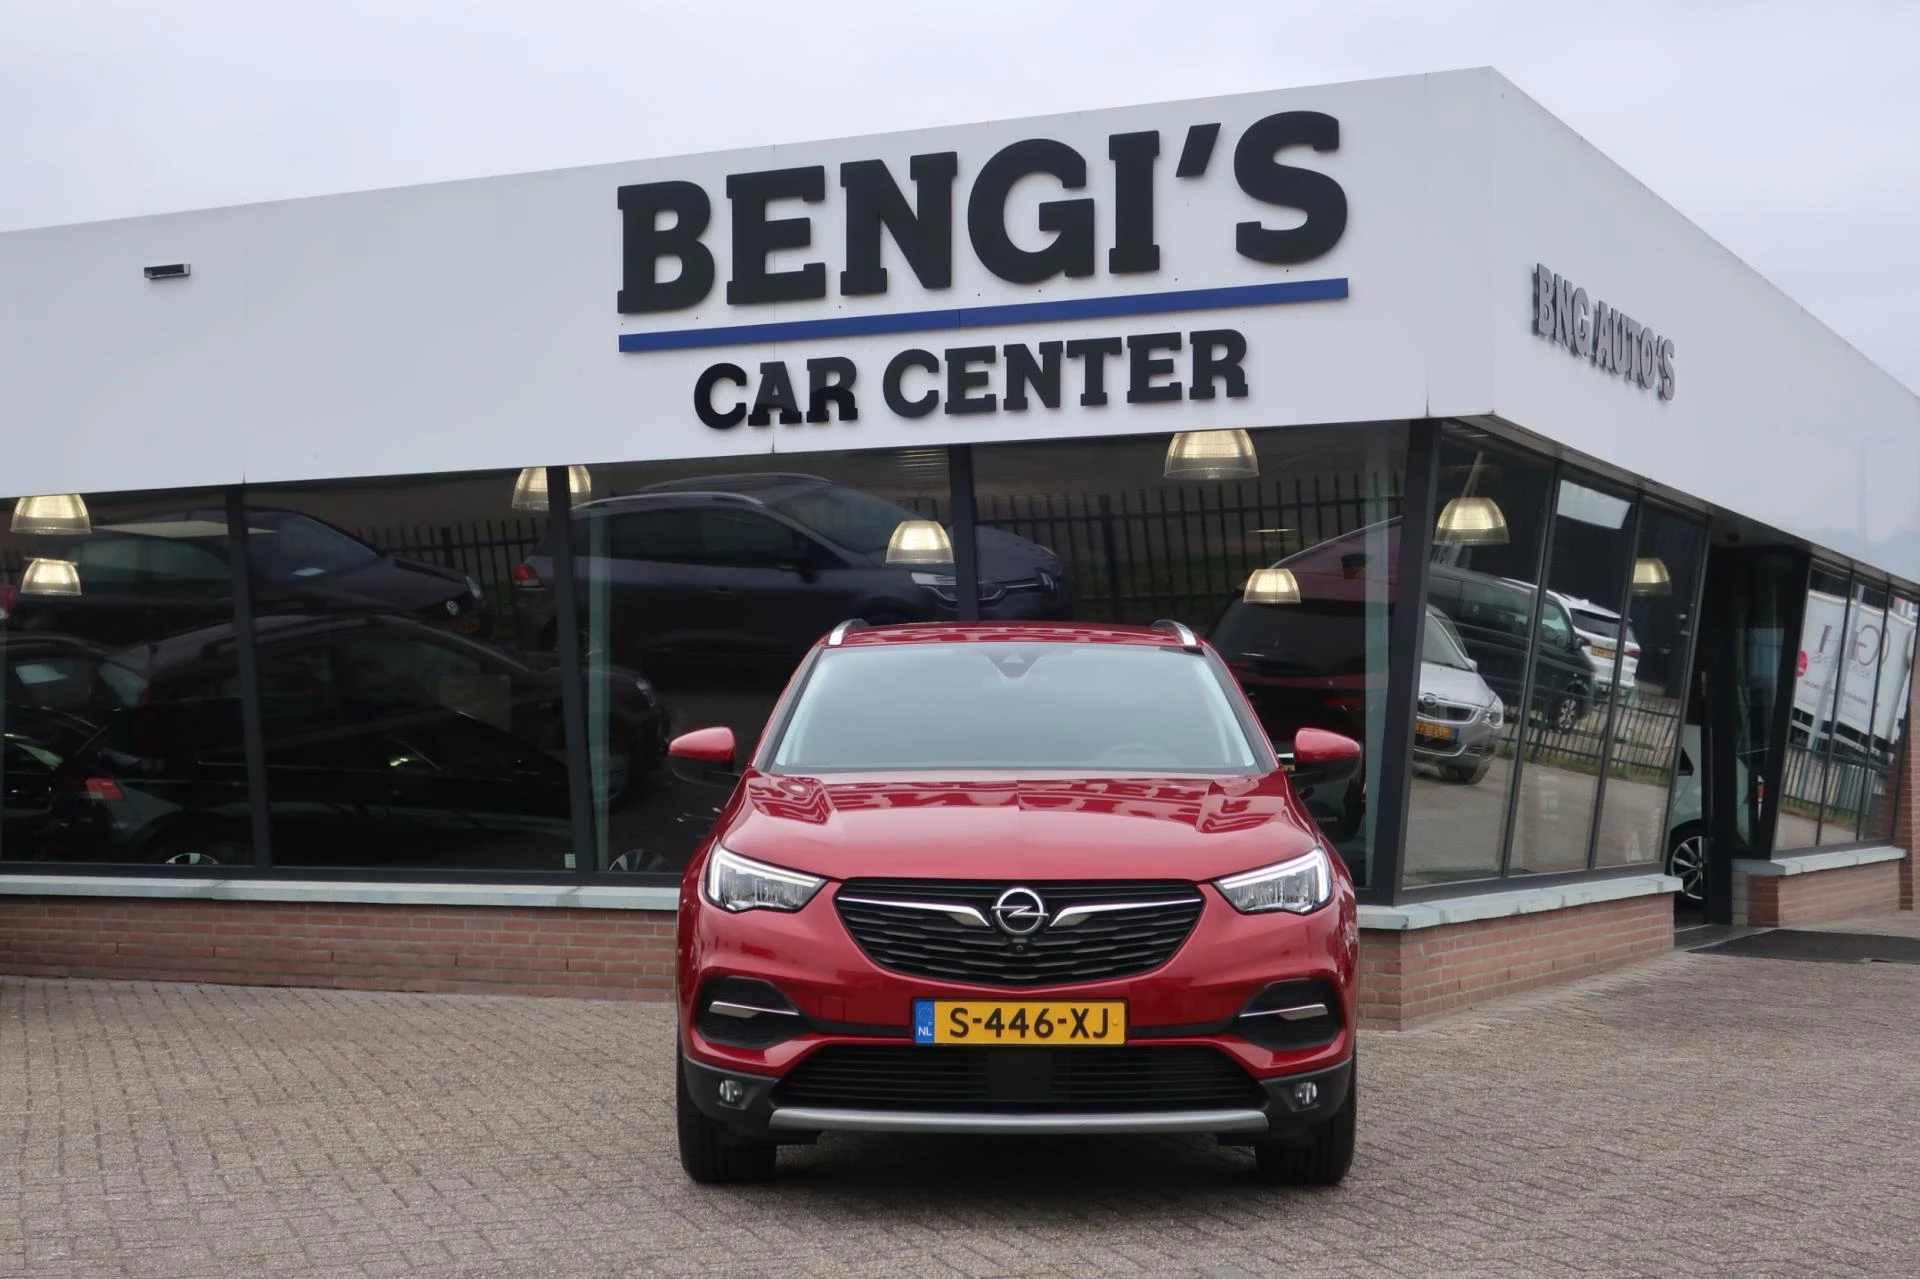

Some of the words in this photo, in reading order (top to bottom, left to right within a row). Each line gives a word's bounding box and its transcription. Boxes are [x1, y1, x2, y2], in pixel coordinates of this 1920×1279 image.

[616, 110, 1348, 314] BENGI'S
[694, 355, 858, 429] CAR
[882, 328, 1249, 419] CENTER
[1533, 263, 1591, 358] BNG
[1593, 300, 1676, 401] AUTO'S
[918, 1026, 932, 1037] NL
[949, 1007, 1109, 1039] S-446-XJ
